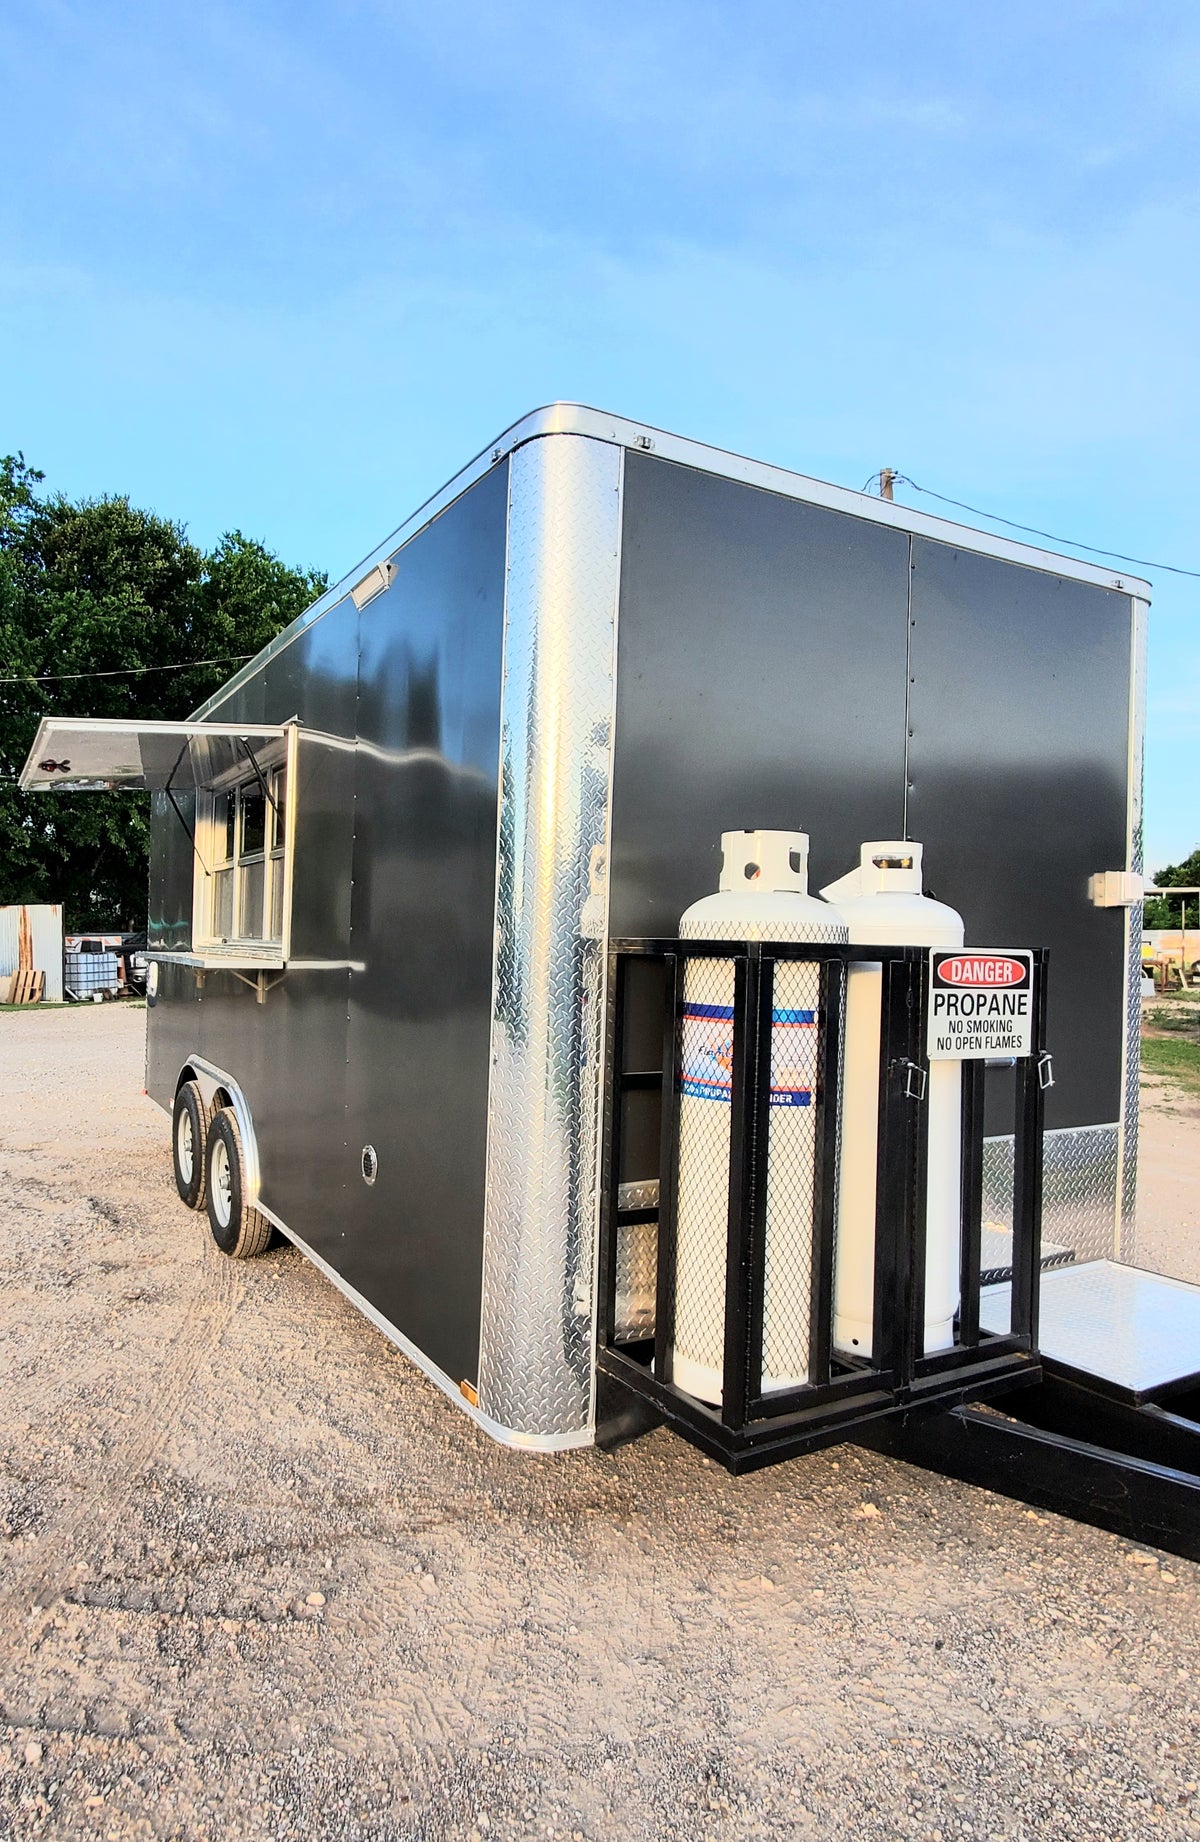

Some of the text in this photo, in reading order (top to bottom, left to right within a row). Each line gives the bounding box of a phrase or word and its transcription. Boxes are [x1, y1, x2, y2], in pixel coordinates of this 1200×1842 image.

[951, 960, 1013, 982] DANGER
[933, 993, 1028, 1016] PROPANE
[948, 1019, 1013, 1034] NO SMOKING
[936, 1034, 1023, 1051] NO OPEN FLAMES
